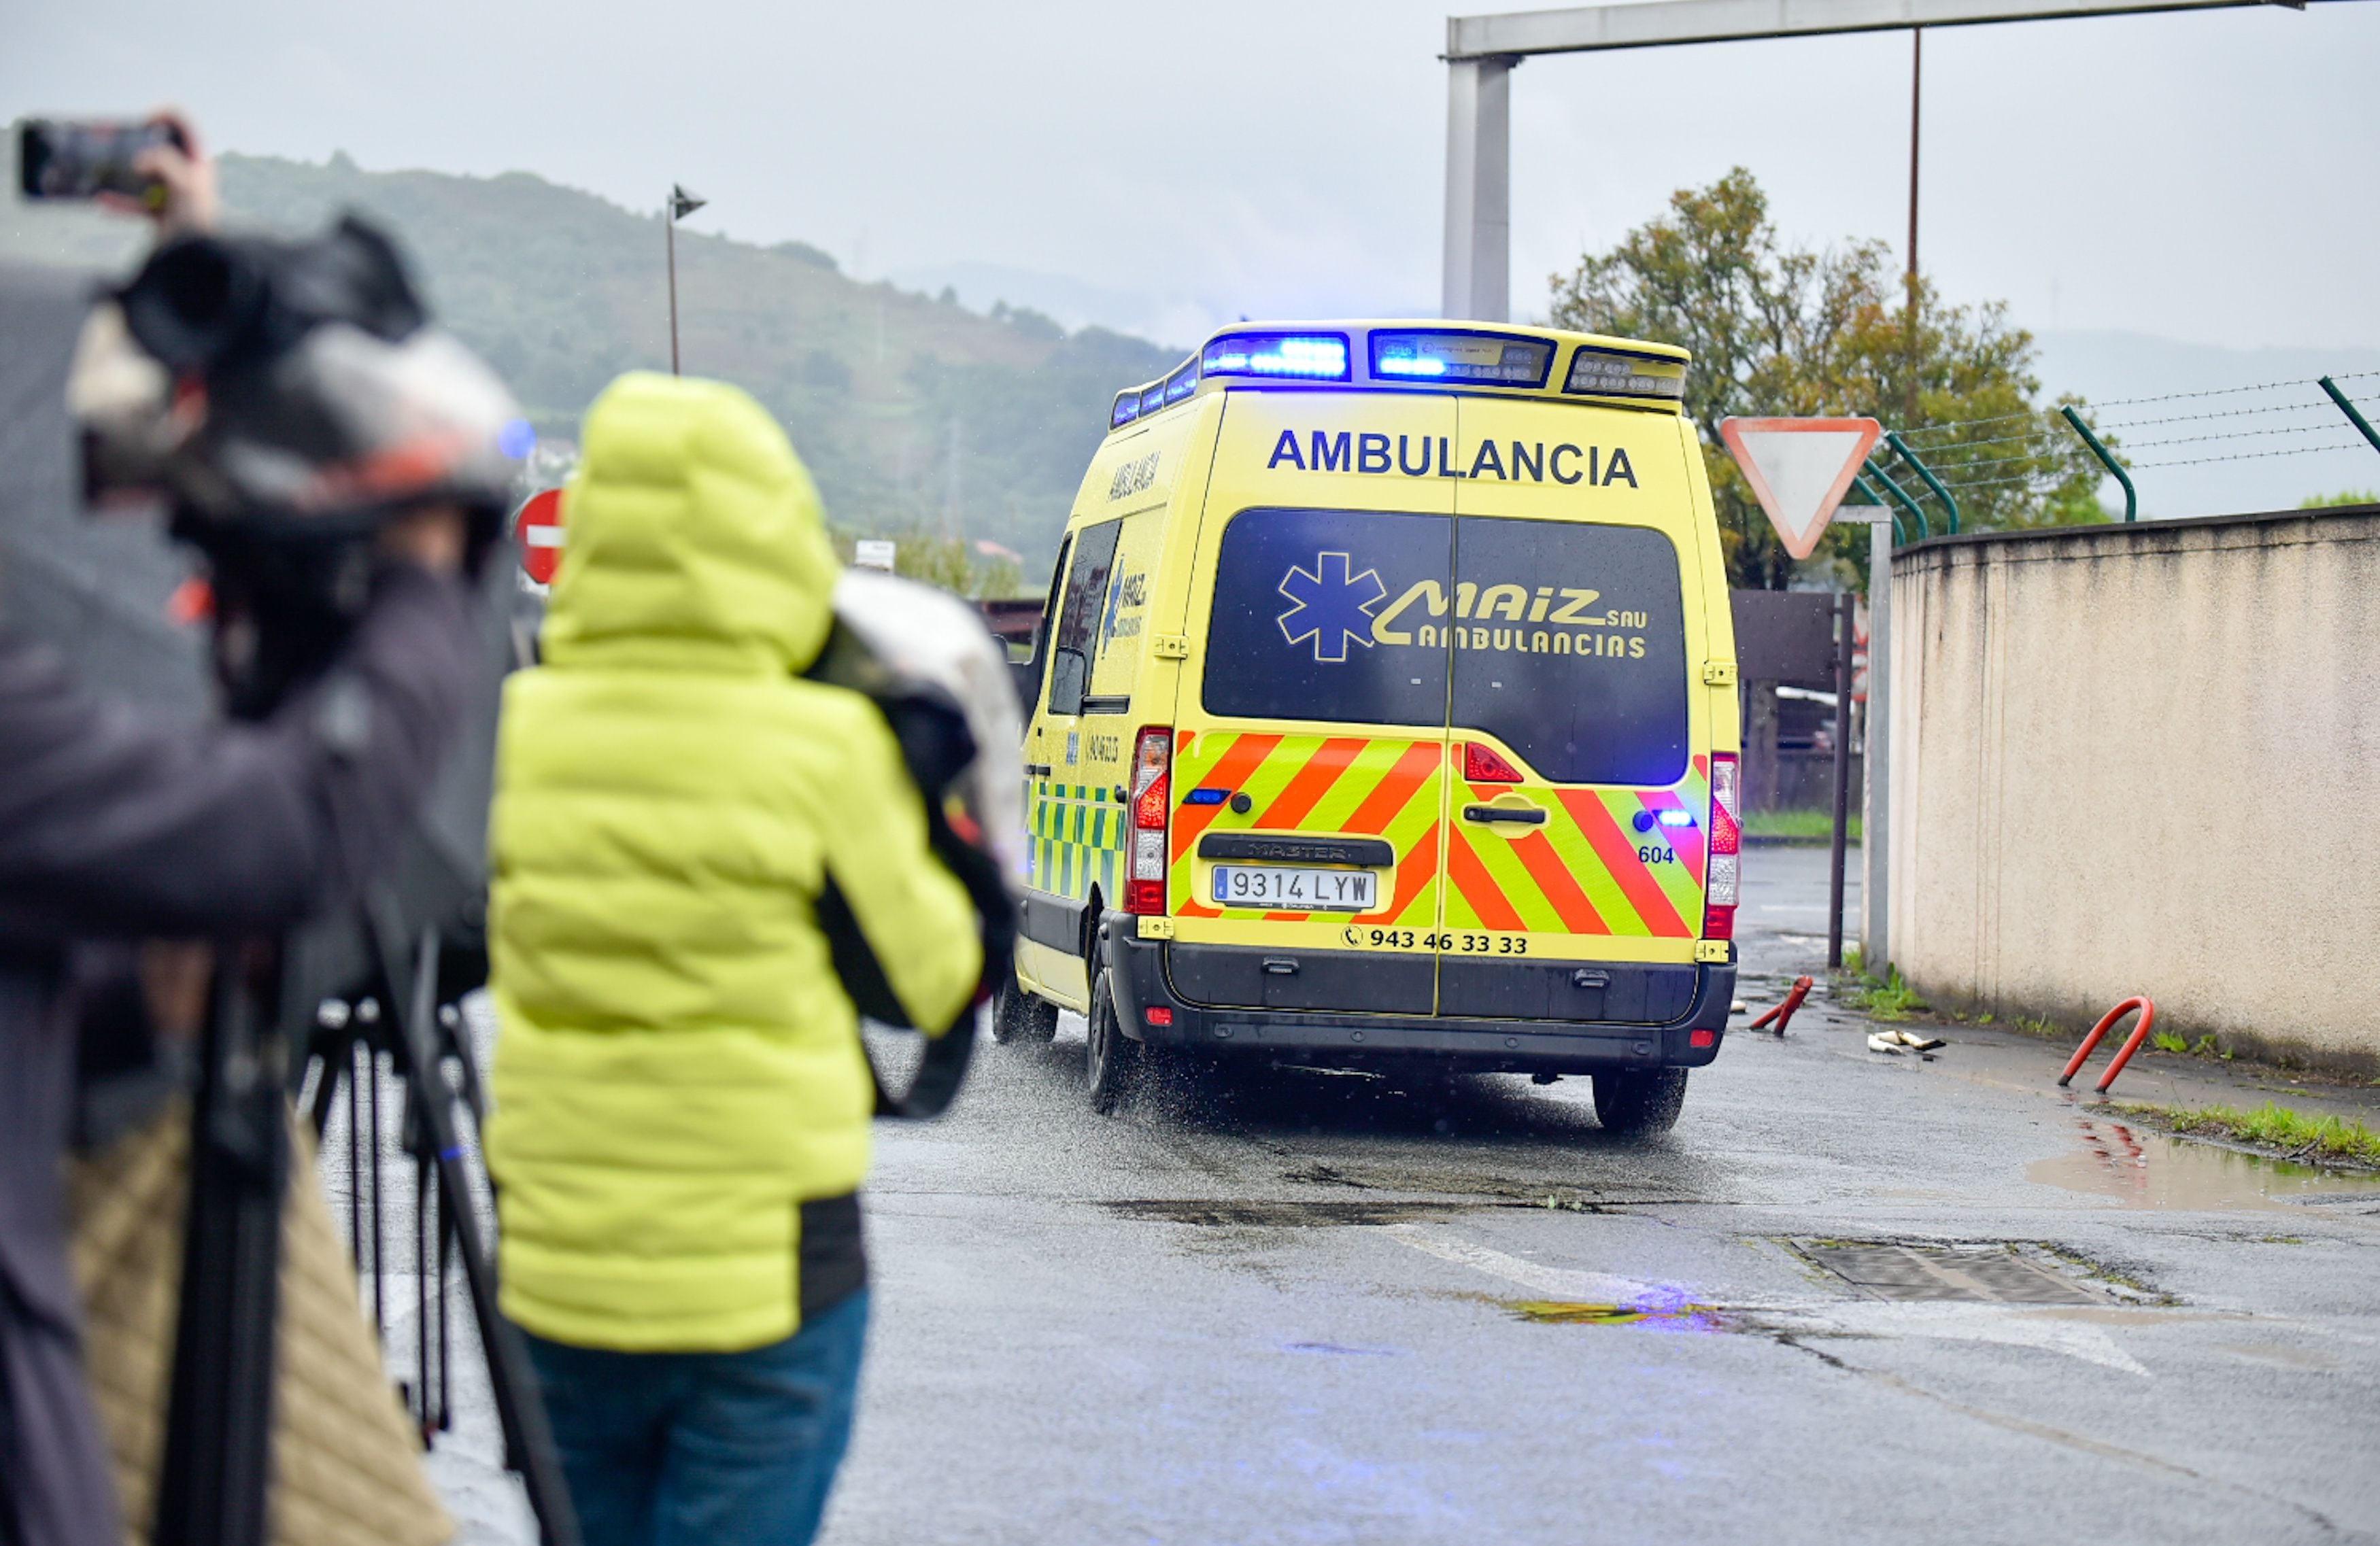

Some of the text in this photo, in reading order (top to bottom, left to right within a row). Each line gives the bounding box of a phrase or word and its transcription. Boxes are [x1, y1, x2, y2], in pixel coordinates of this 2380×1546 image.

[1266, 430, 1639, 489] AMBULANCIA
[1606, 609, 1648, 629] SAU
[1418, 624, 1646, 659] AMBULANCIAS
[1247, 843, 1346, 860] MASTER
[1639, 846, 1674, 864] 604
[1234, 872, 1367, 901] 9314 LYW
[1370, 929, 1527, 954] 943 46 33 33
